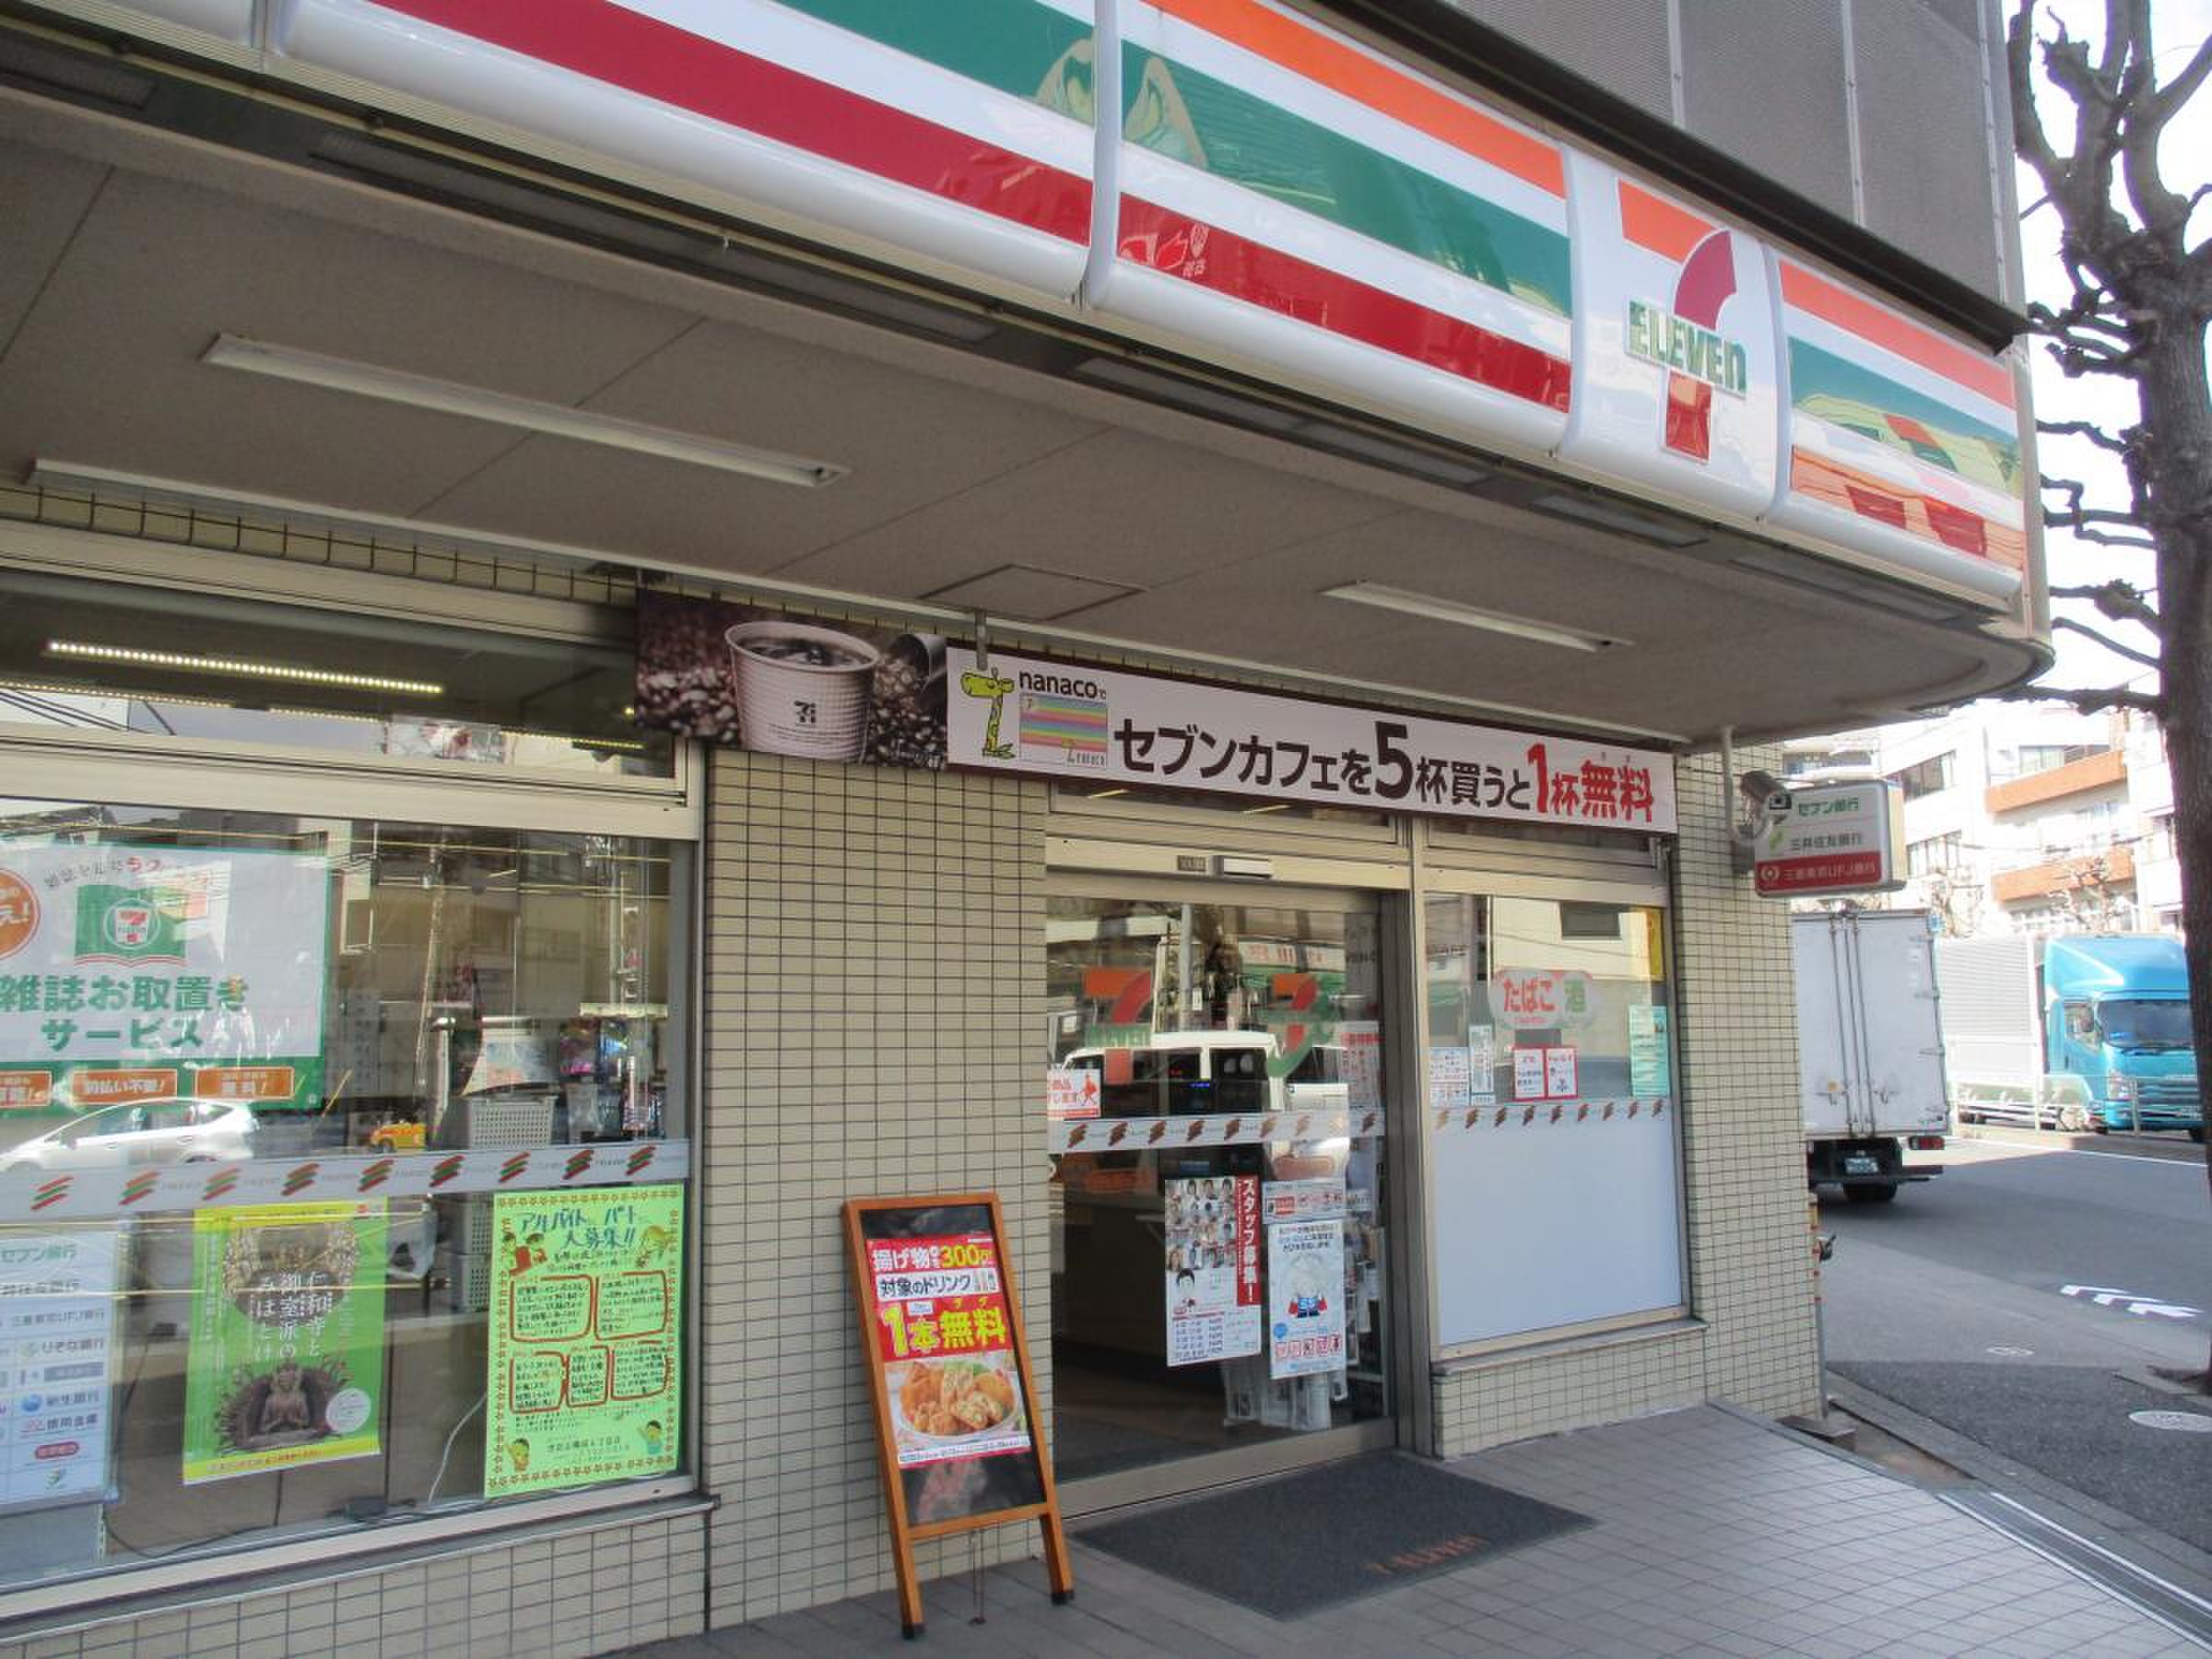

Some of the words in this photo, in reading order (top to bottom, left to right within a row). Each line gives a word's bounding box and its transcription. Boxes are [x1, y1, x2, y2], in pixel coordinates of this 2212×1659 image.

[1503, 977, 1555, 1012] たばこ
[41, 1018, 203, 1052] サービス
[879, 1274, 971, 1298] 対象のドリンク
